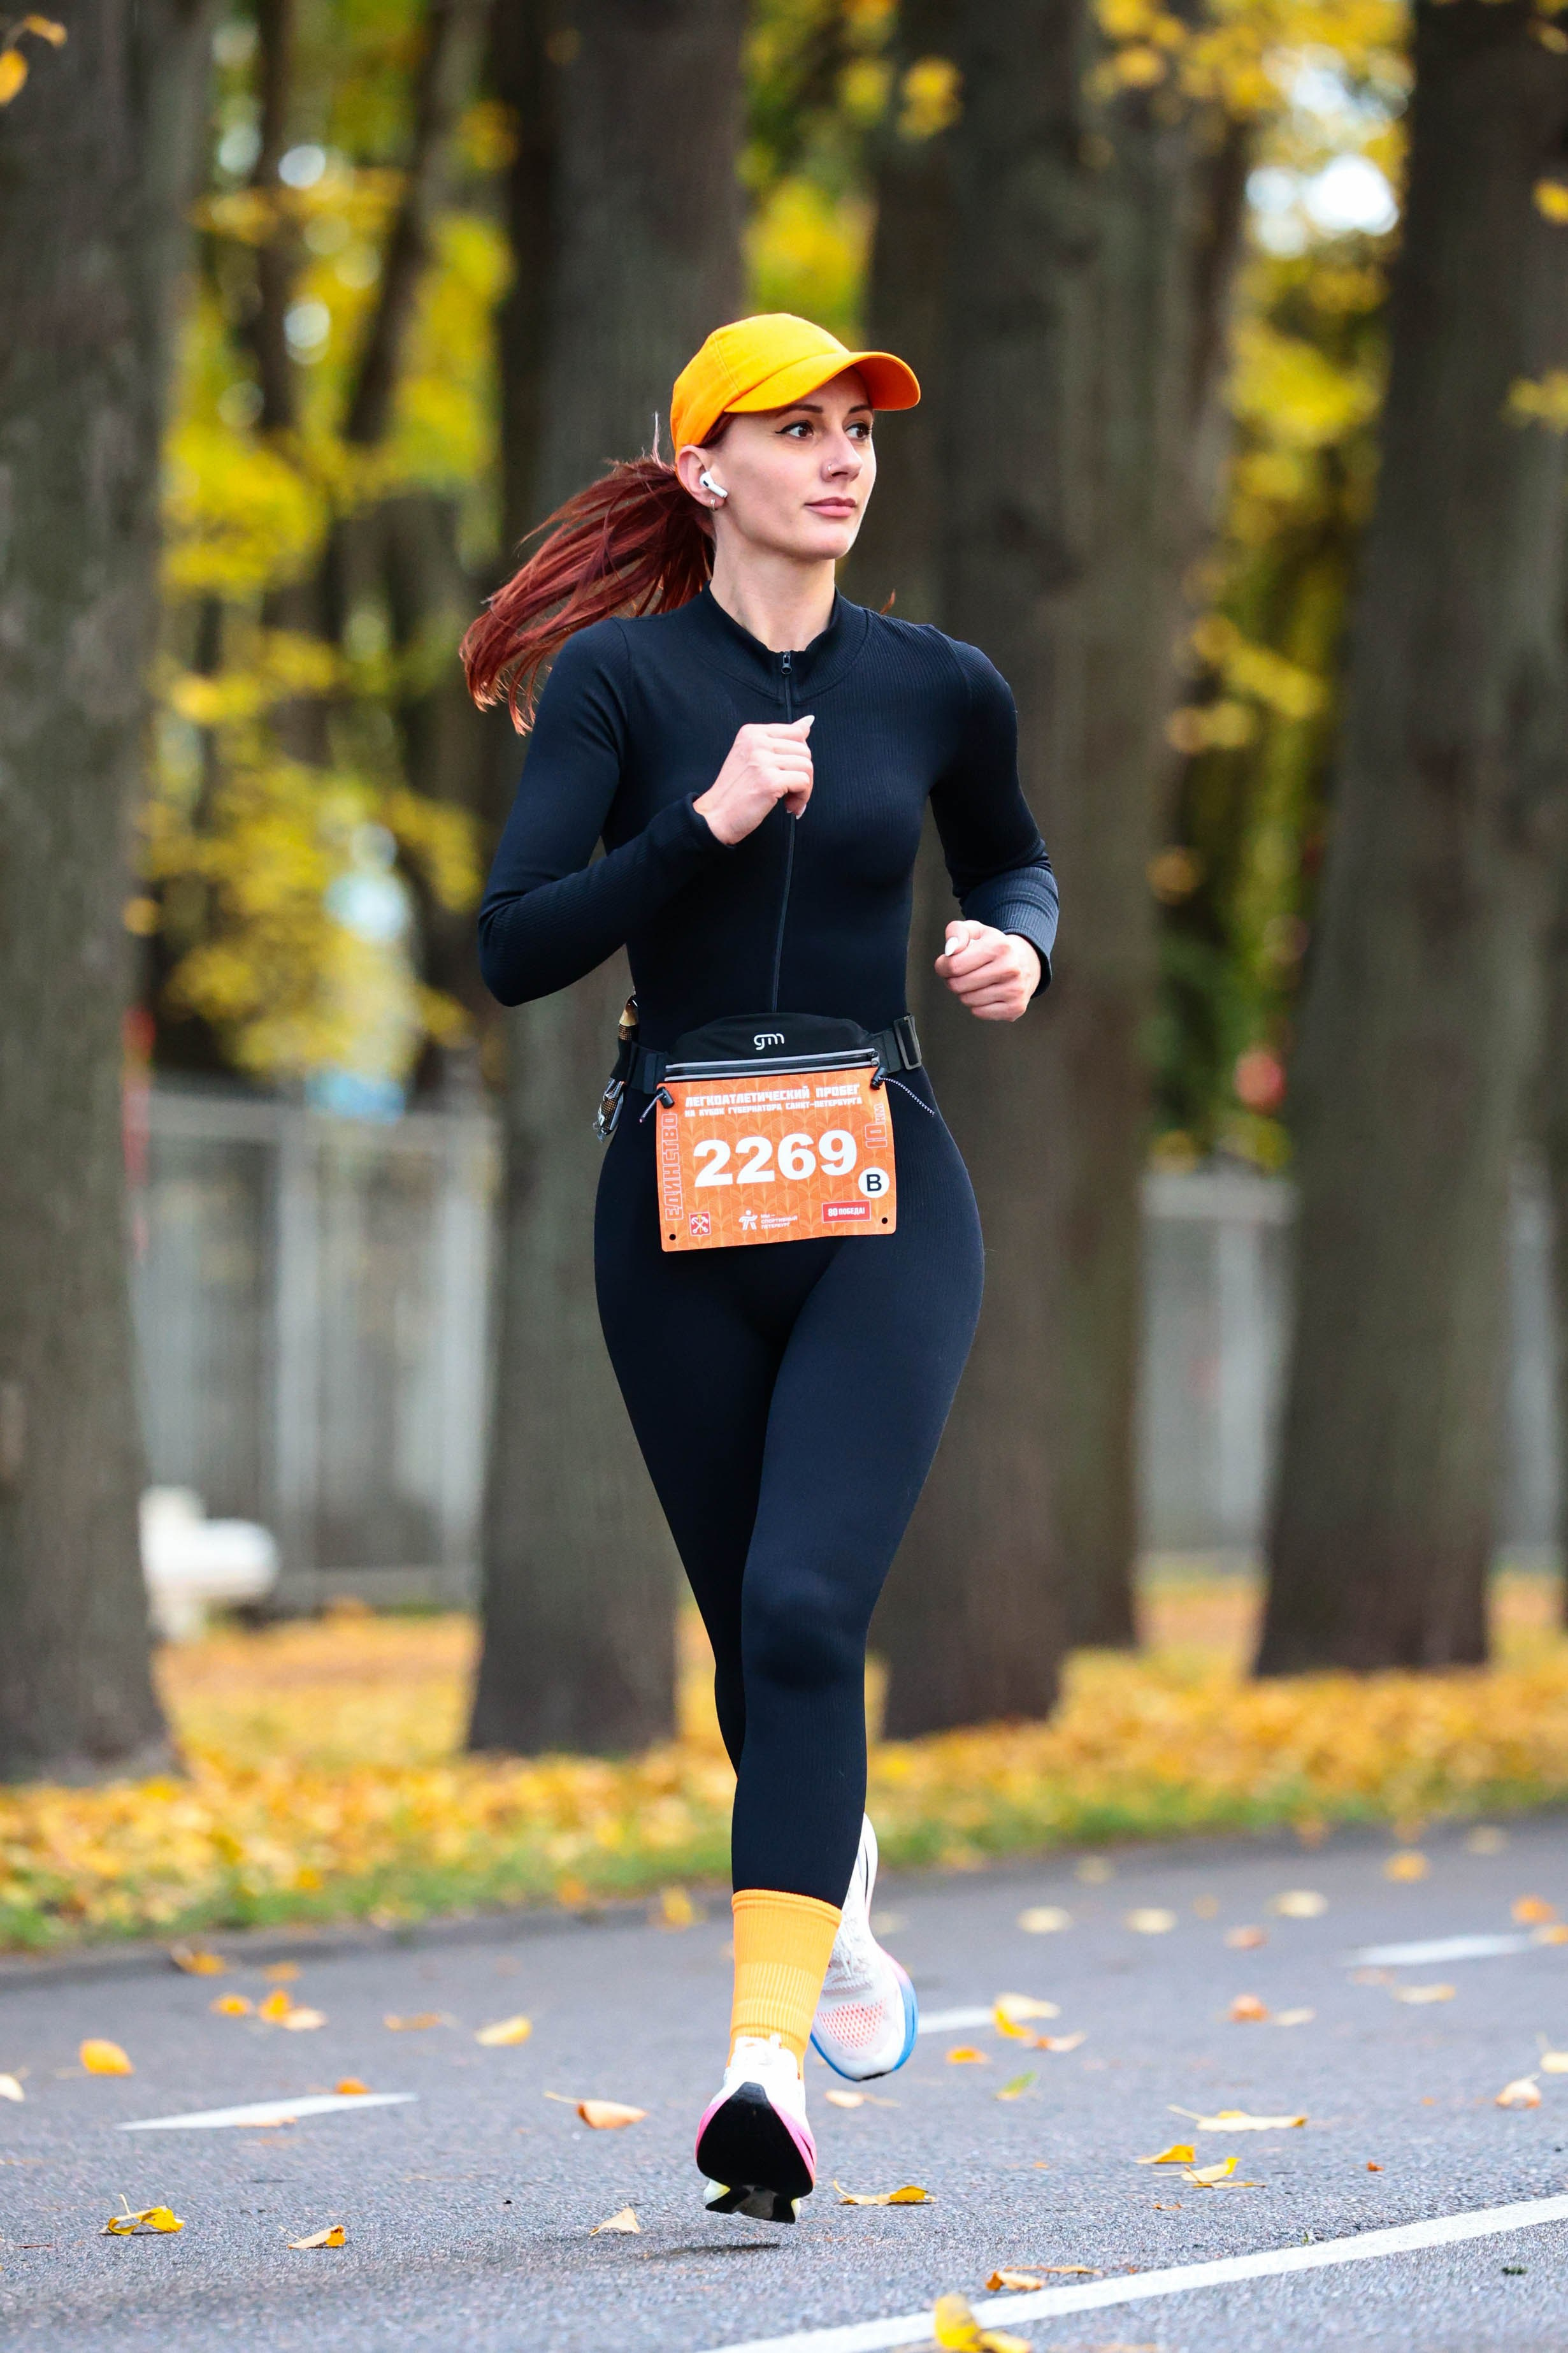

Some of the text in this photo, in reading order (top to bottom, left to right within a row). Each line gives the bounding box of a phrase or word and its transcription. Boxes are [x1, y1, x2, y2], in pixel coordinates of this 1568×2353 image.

[685, 1083, 860, 1107] ЛЕГКОАТЛЕТИЧЕСКИЙ ПРОБЕГ
[699, 1108, 725, 1117] КУБОК
[728, 1103, 782, 1115] ГУБЕРНАТОРА
[661, 1113, 684, 1221] ЕДИНСТВО
[693, 1129, 858, 1187] 2269
